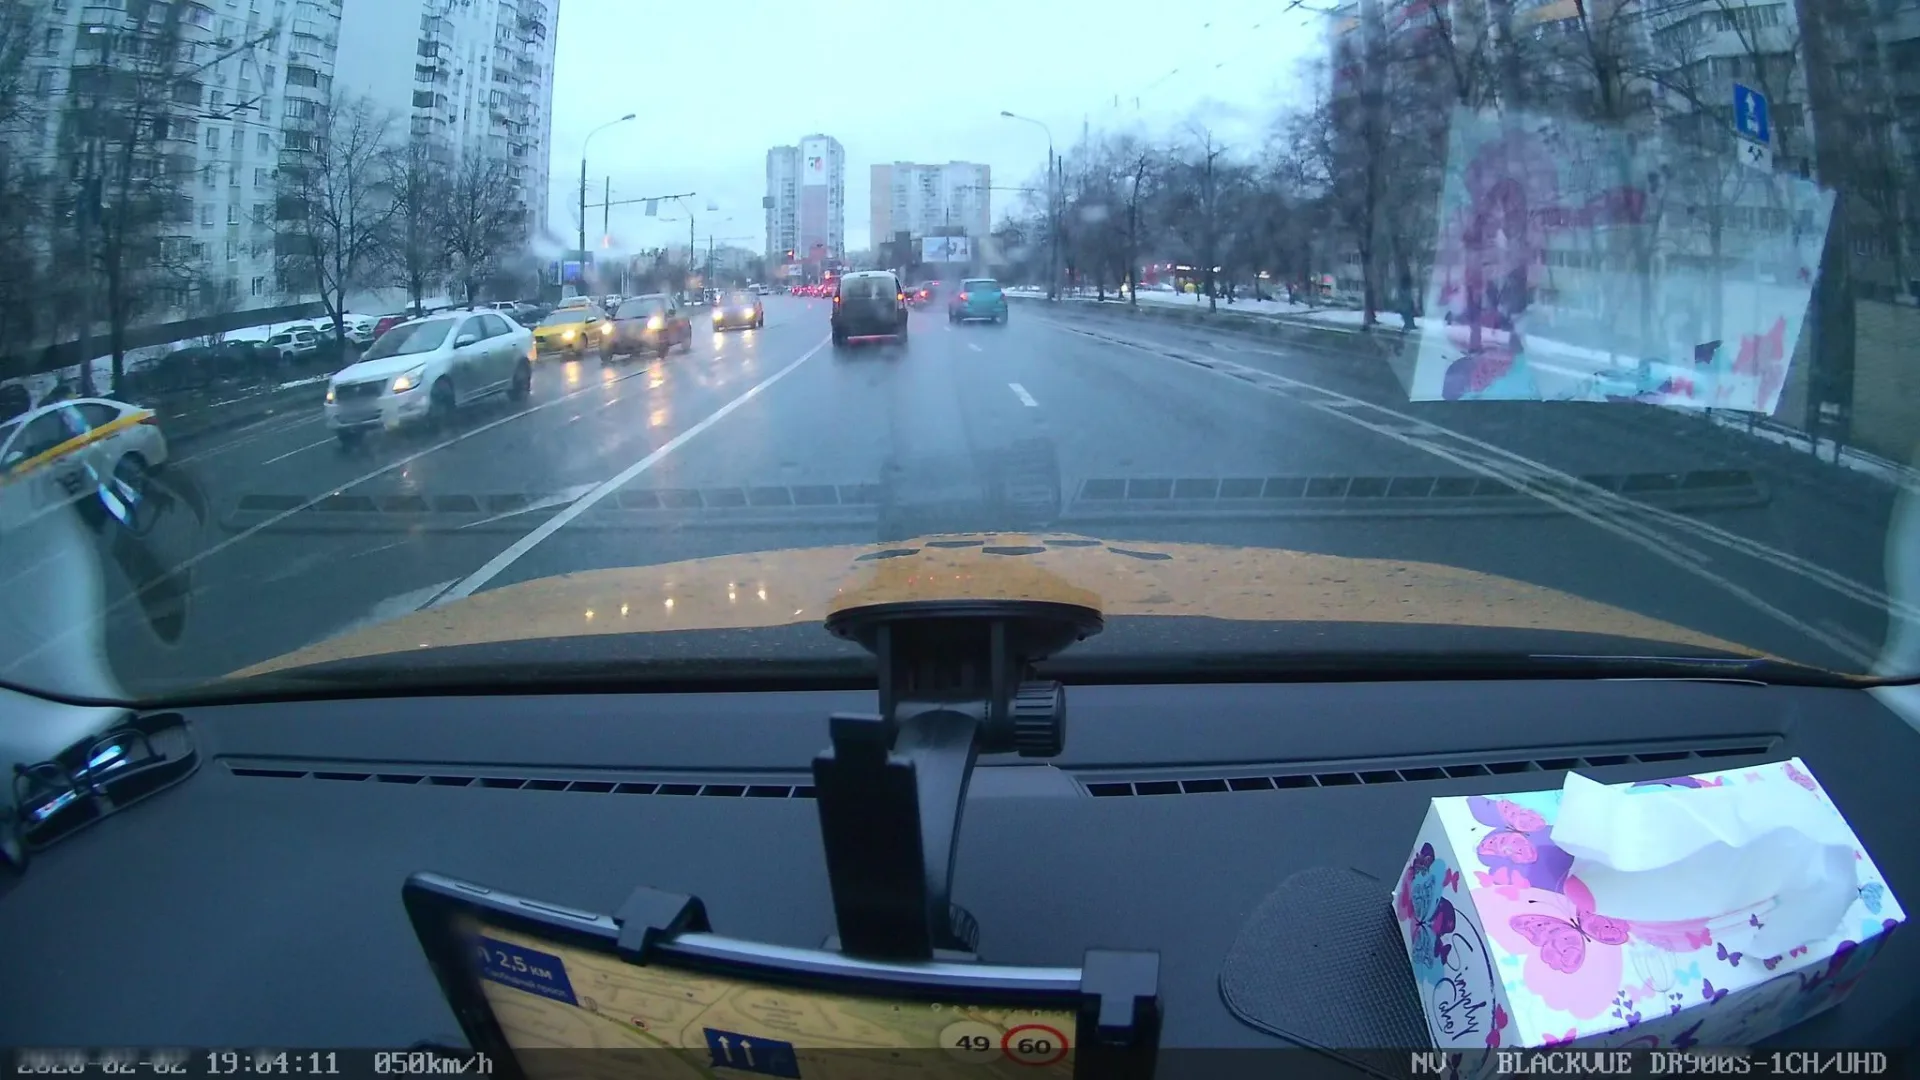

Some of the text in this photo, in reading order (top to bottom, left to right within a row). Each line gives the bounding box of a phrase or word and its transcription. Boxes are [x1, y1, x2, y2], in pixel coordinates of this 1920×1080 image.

[496, 950, 528, 973] 2,5
[1447, 932, 1487, 1041] Simply
[955, 1035, 990, 1053] 49
[1017, 1038, 1052, 1055] 60
